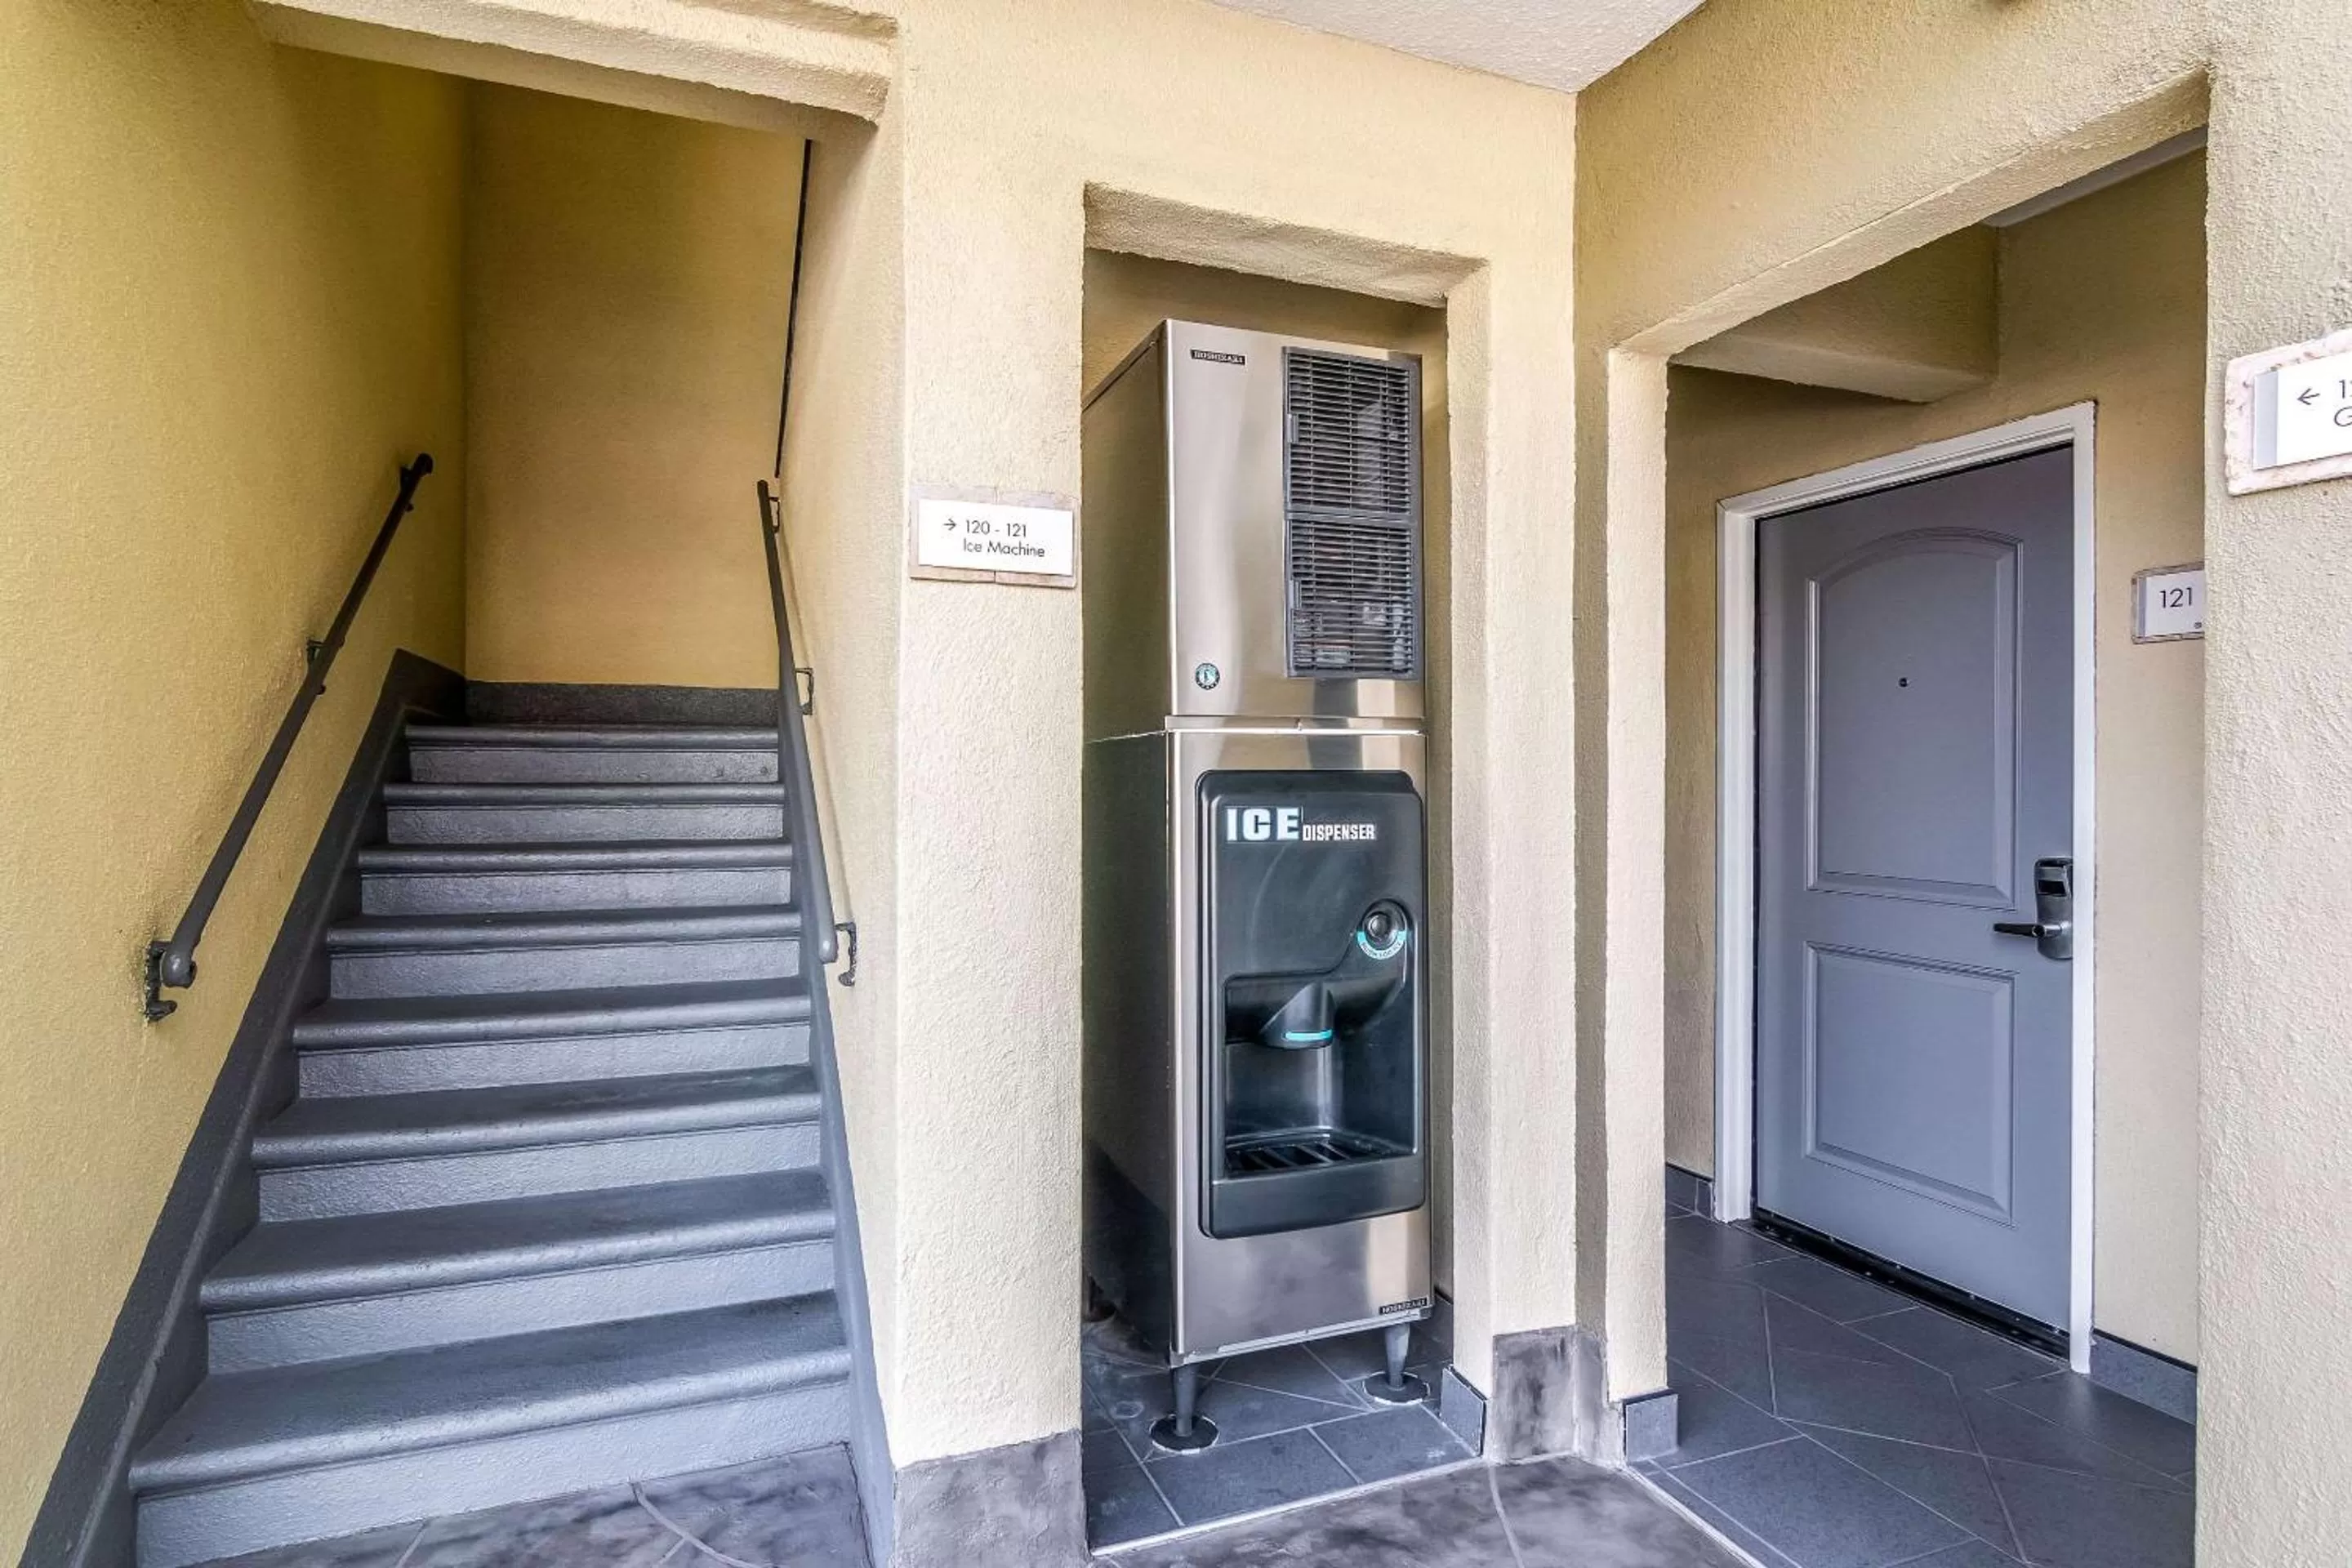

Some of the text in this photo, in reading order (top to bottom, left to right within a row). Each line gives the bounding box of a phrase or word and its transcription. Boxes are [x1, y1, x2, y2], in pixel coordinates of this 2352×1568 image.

[2338, 379, 2352, 399] 1
[965, 519, 991, 535] 120
[1006, 523, 1027, 537] 121
[963, 537, 1045, 557] Ice Machine
[2159, 586, 2192, 608] 121
[1227, 808, 1375, 841] ICE DISPENSER
